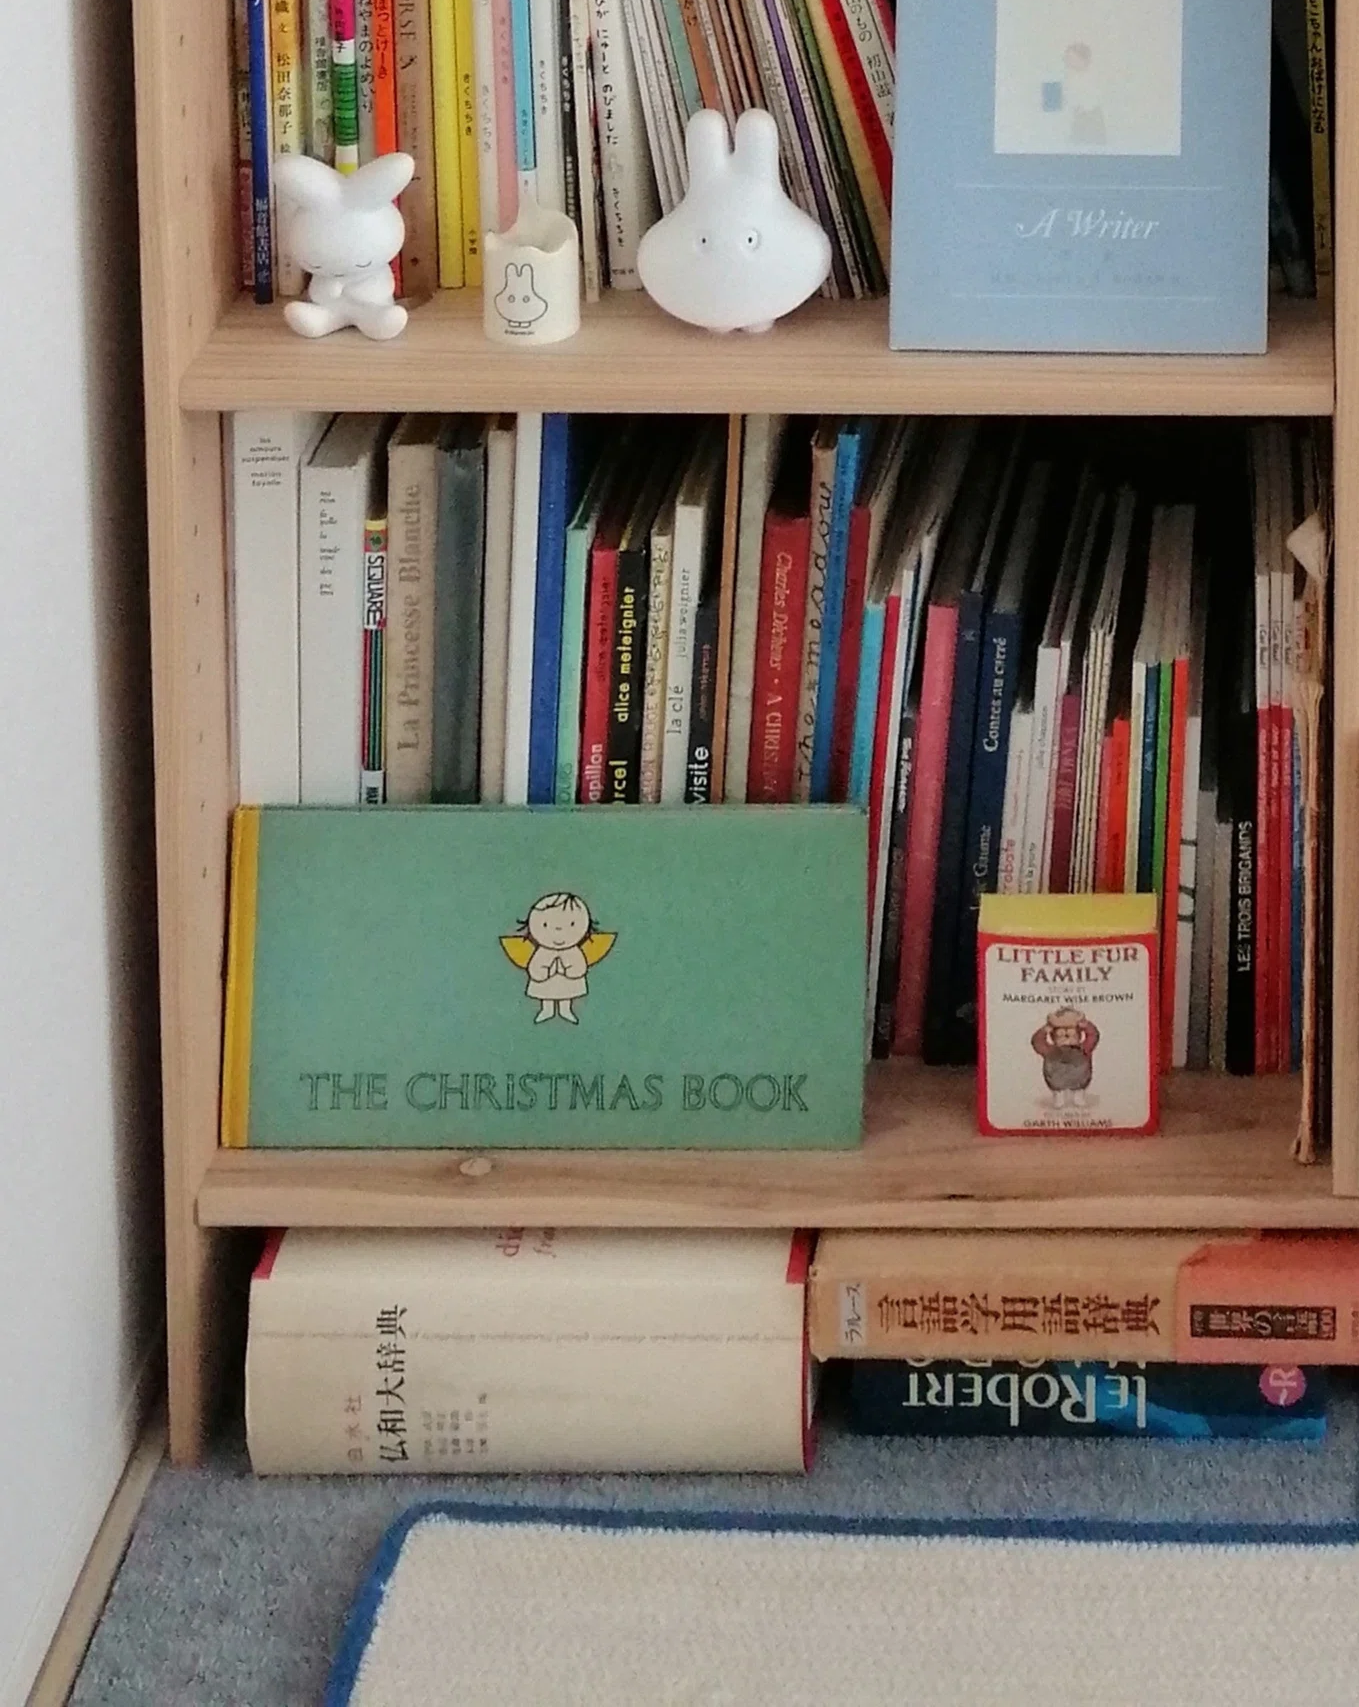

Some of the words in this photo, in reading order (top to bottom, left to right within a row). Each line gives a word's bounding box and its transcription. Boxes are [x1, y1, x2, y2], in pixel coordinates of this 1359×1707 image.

[1015, 209, 1053, 237] A
[1066, 208, 1160, 240] Writer
[398, 483, 422, 583] Blanche
[399, 594, 422, 708] Princesse
[992, 636, 1008, 676] carré
[615, 681, 631, 723] alice
[668, 686, 685, 717] clé
[397, 715, 420, 751] La
[983, 704, 1003, 753] Contes
[1240, 821, 1253, 903] BRIGANDS
[1238, 908, 1251, 947] TROIS
[997, 947, 1087, 965] LITTLE
[1091, 947, 1138, 963] FUR
[1021, 966, 1112, 983] FAMILY
[1002, 993, 1060, 1003] MARGARET
[1092, 993, 1134, 1003] BROWN
[301, 1073, 387, 1112] THE
[405, 1073, 663, 1112] CHRISTMAS
[682, 1073, 810, 1112] BOOK
[877, 1291, 1161, 1337] 言語学用語辞典
[375, 1304, 409, 1463] 仏和大辞典
